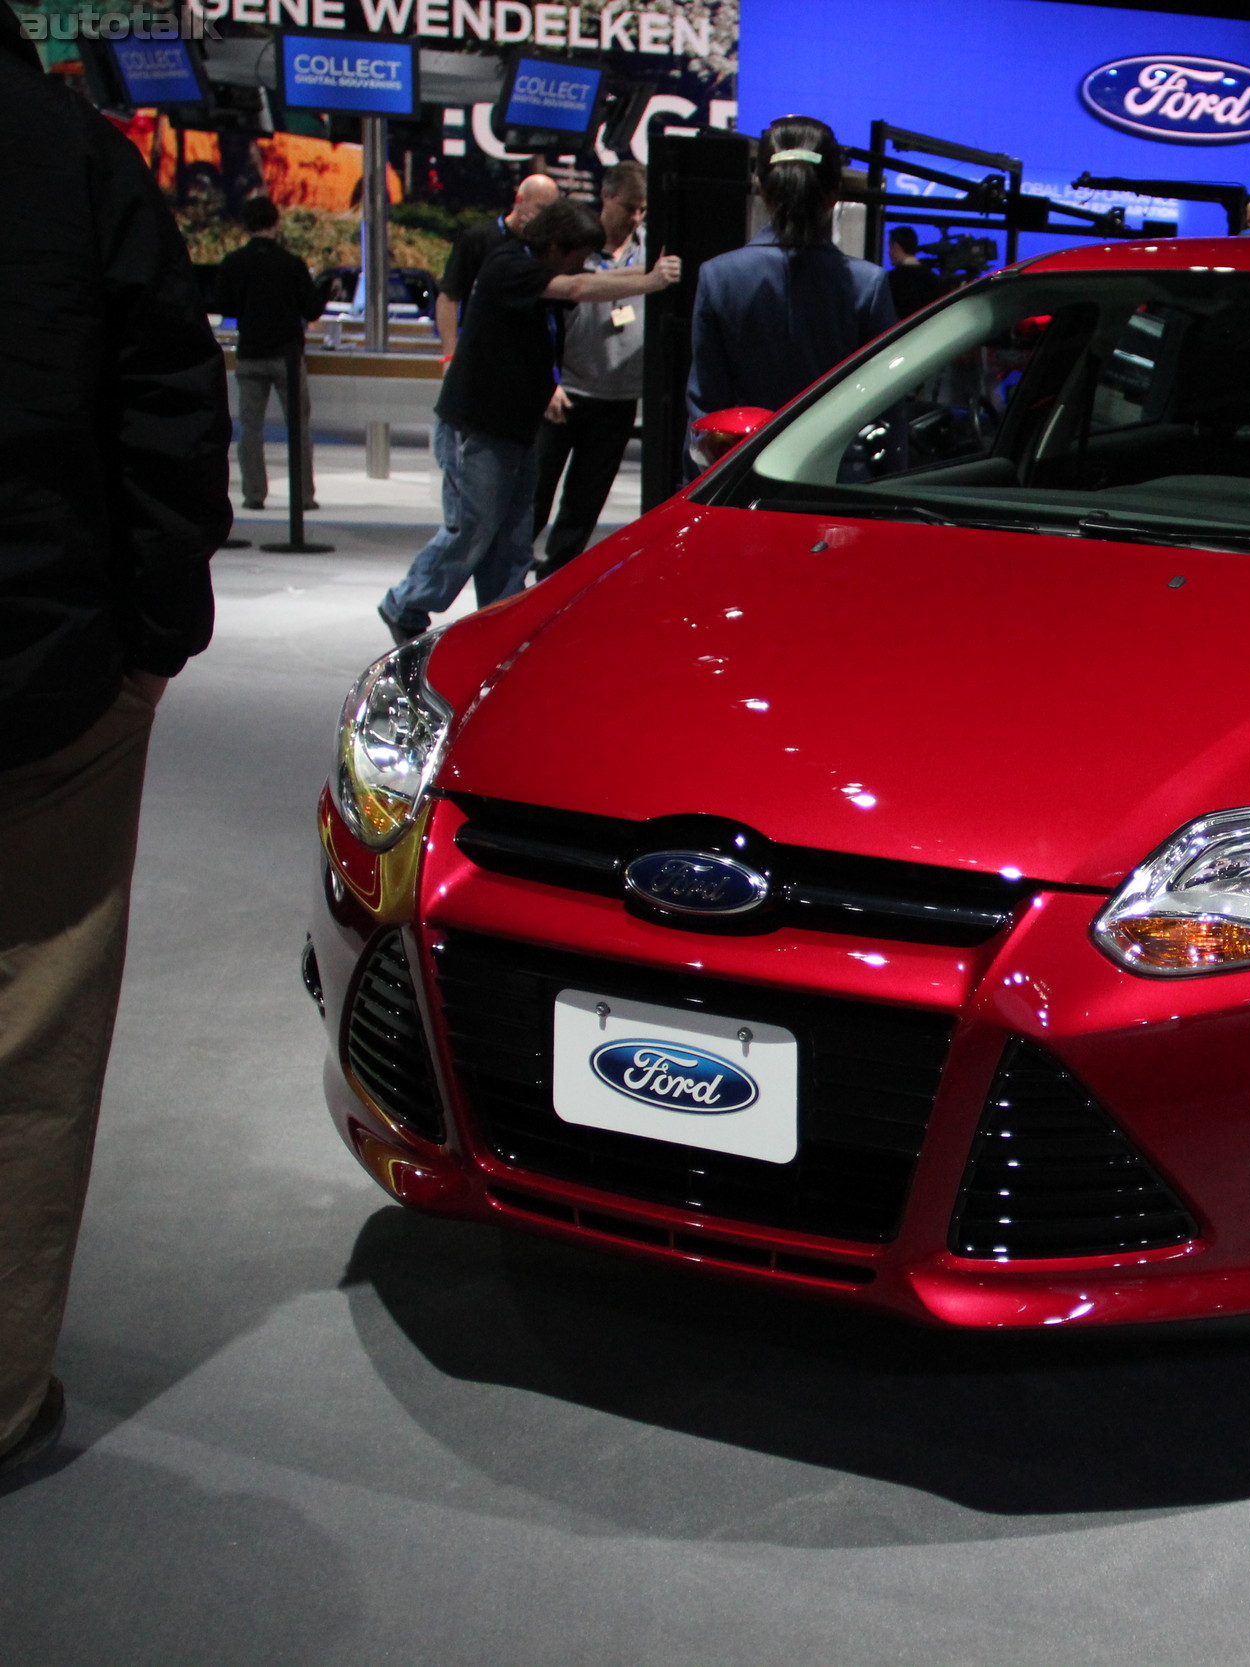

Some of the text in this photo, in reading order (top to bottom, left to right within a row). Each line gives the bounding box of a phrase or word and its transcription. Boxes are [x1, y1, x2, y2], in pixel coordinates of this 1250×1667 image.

[360, 0, 711, 57] WENDELKEN
[294, 54, 402, 79] COLLECT
[515, 75, 591, 100] COLLECT
[651, 859, 731, 901] Ford
[623, 1049, 724, 1104] Ford
